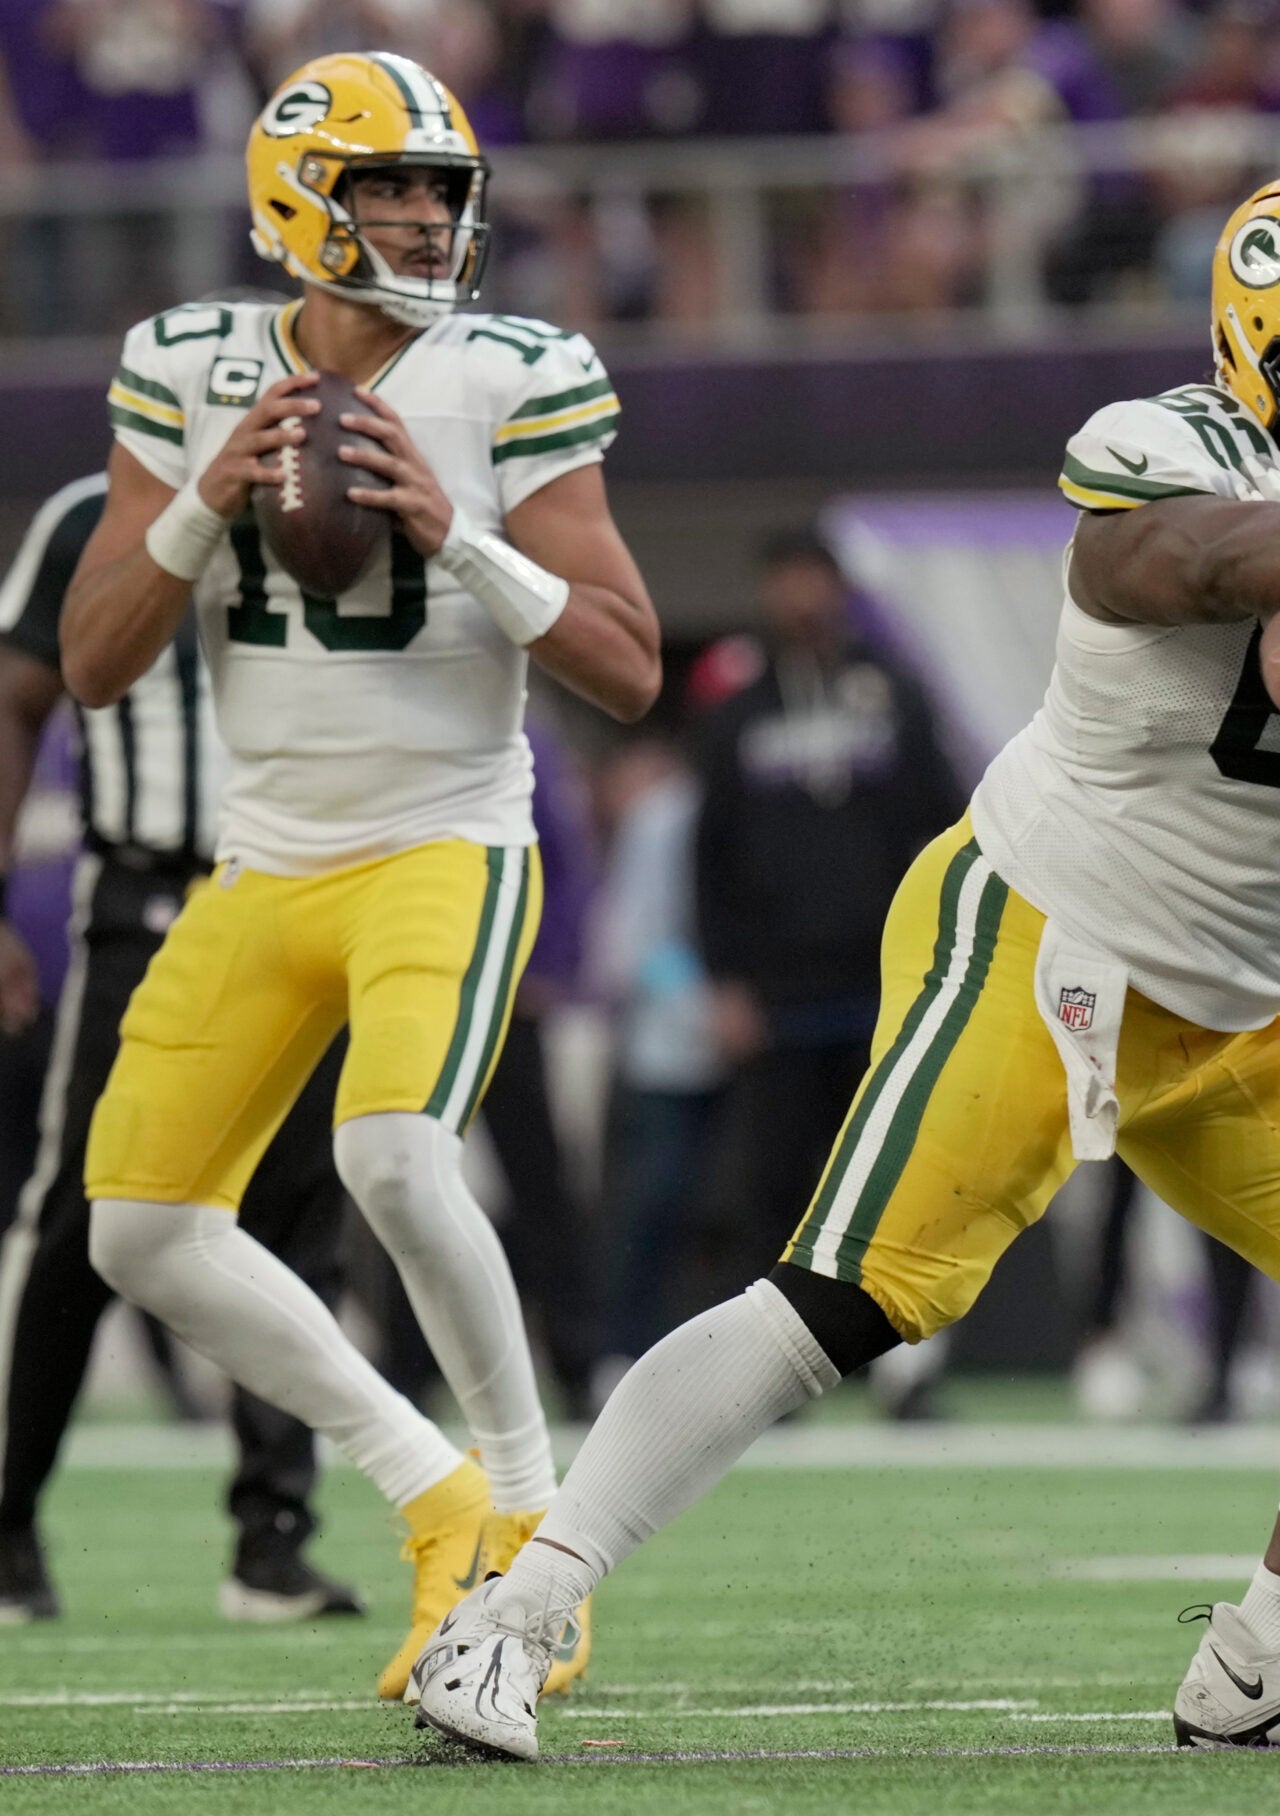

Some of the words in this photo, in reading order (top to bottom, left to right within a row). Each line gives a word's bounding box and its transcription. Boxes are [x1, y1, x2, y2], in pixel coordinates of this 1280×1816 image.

[261, 81, 331, 139] G
[209, 359, 261, 398] C
[1060, 1003, 1090, 1029] NFL
